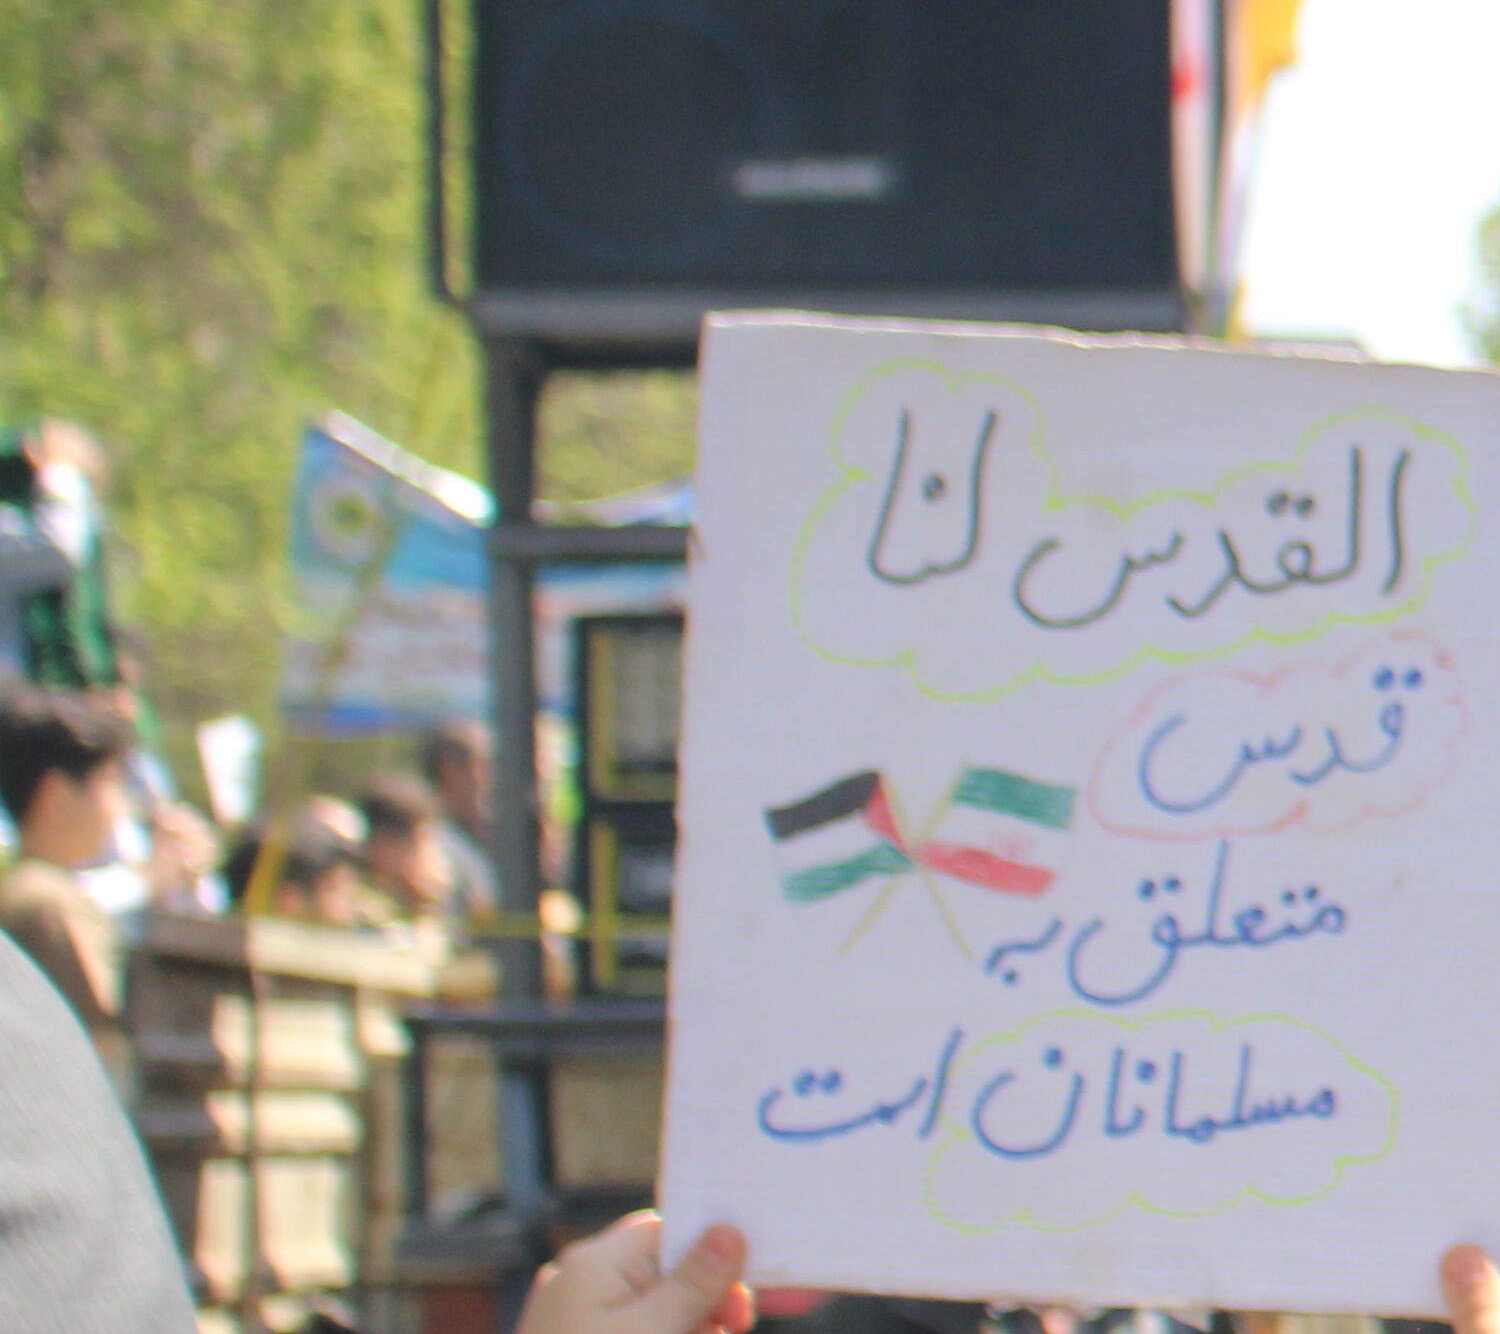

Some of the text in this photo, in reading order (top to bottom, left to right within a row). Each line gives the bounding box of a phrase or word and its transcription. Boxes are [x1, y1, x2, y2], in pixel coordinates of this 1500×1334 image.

[866, 406, 1410, 629] القدس لنا
[1138, 667, 1424, 813] قدس
[1066, 837, 1347, 1008] متعلق
[969, 1043, 1338, 1161] مسلمانان
